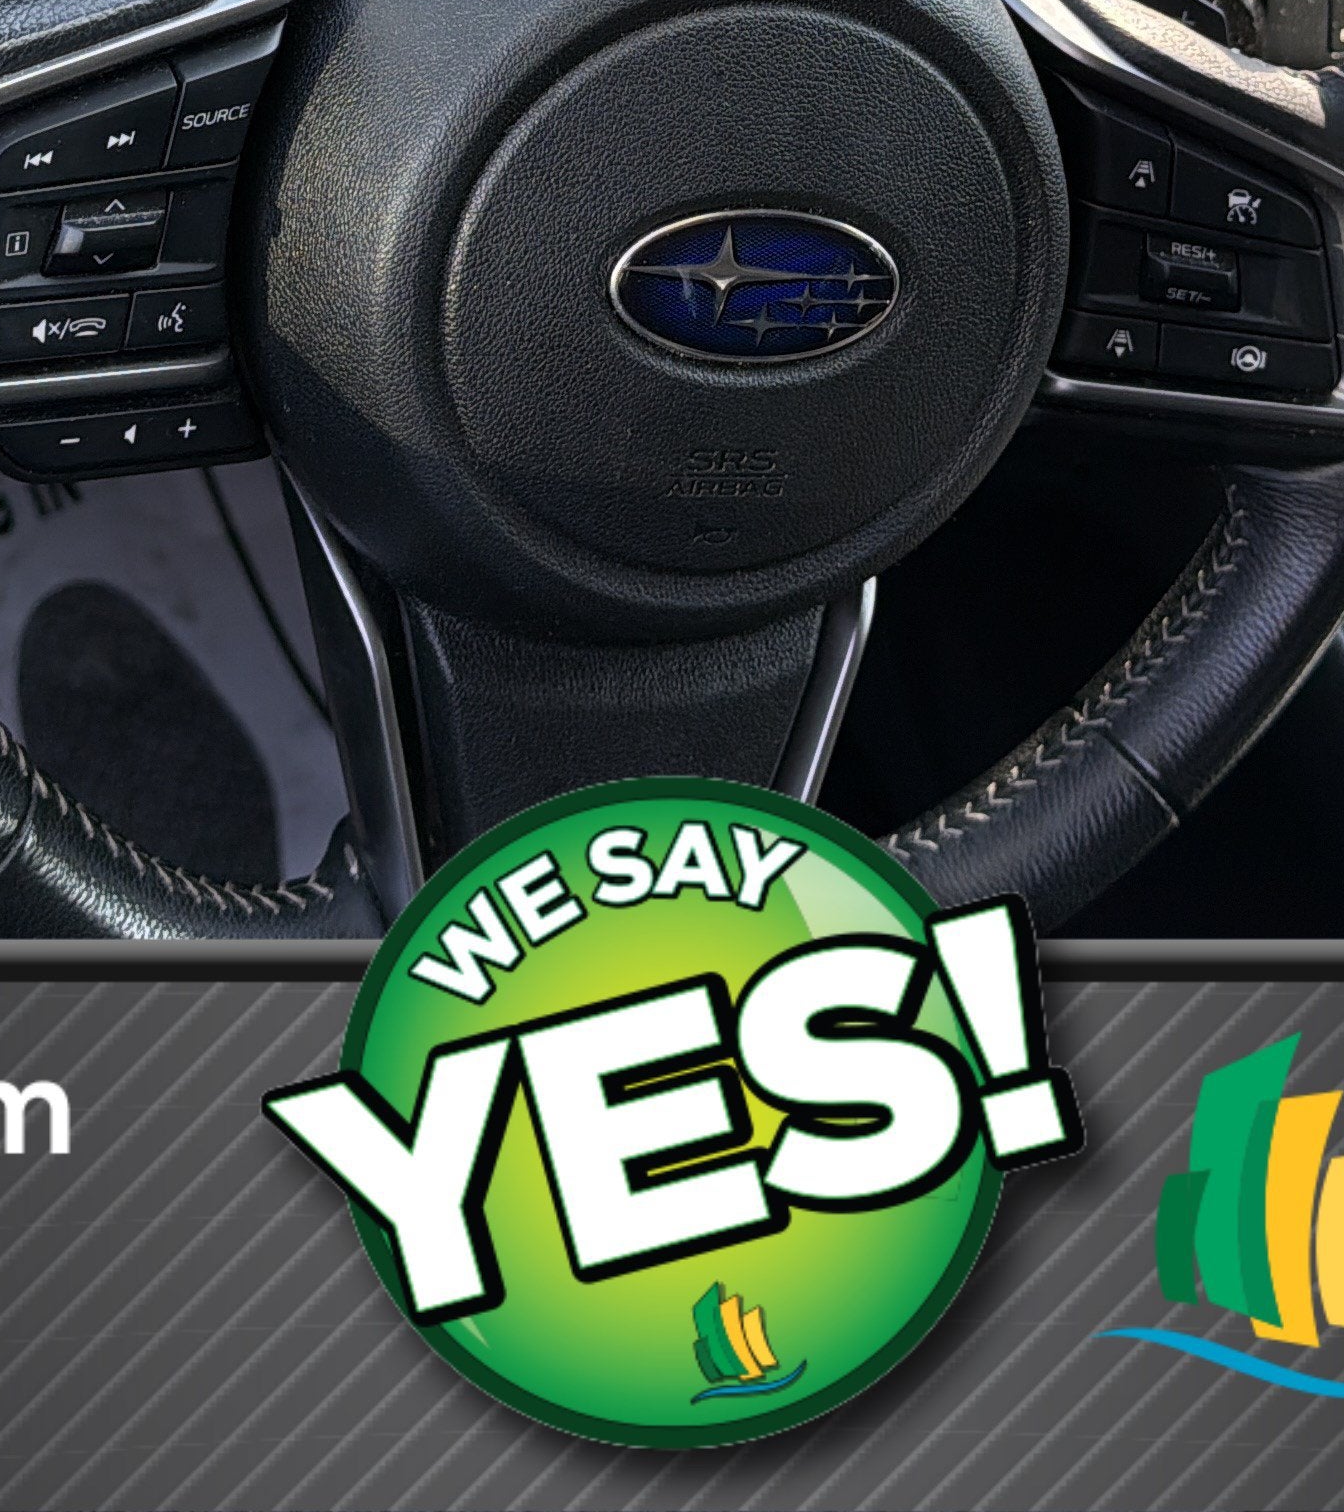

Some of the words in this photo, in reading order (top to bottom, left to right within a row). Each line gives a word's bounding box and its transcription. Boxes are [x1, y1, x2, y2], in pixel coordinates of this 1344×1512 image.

[181, 102, 251, 130] SOURCE
[690, 449, 778, 474] SRS
[663, 479, 785, 498] AIRBAG
